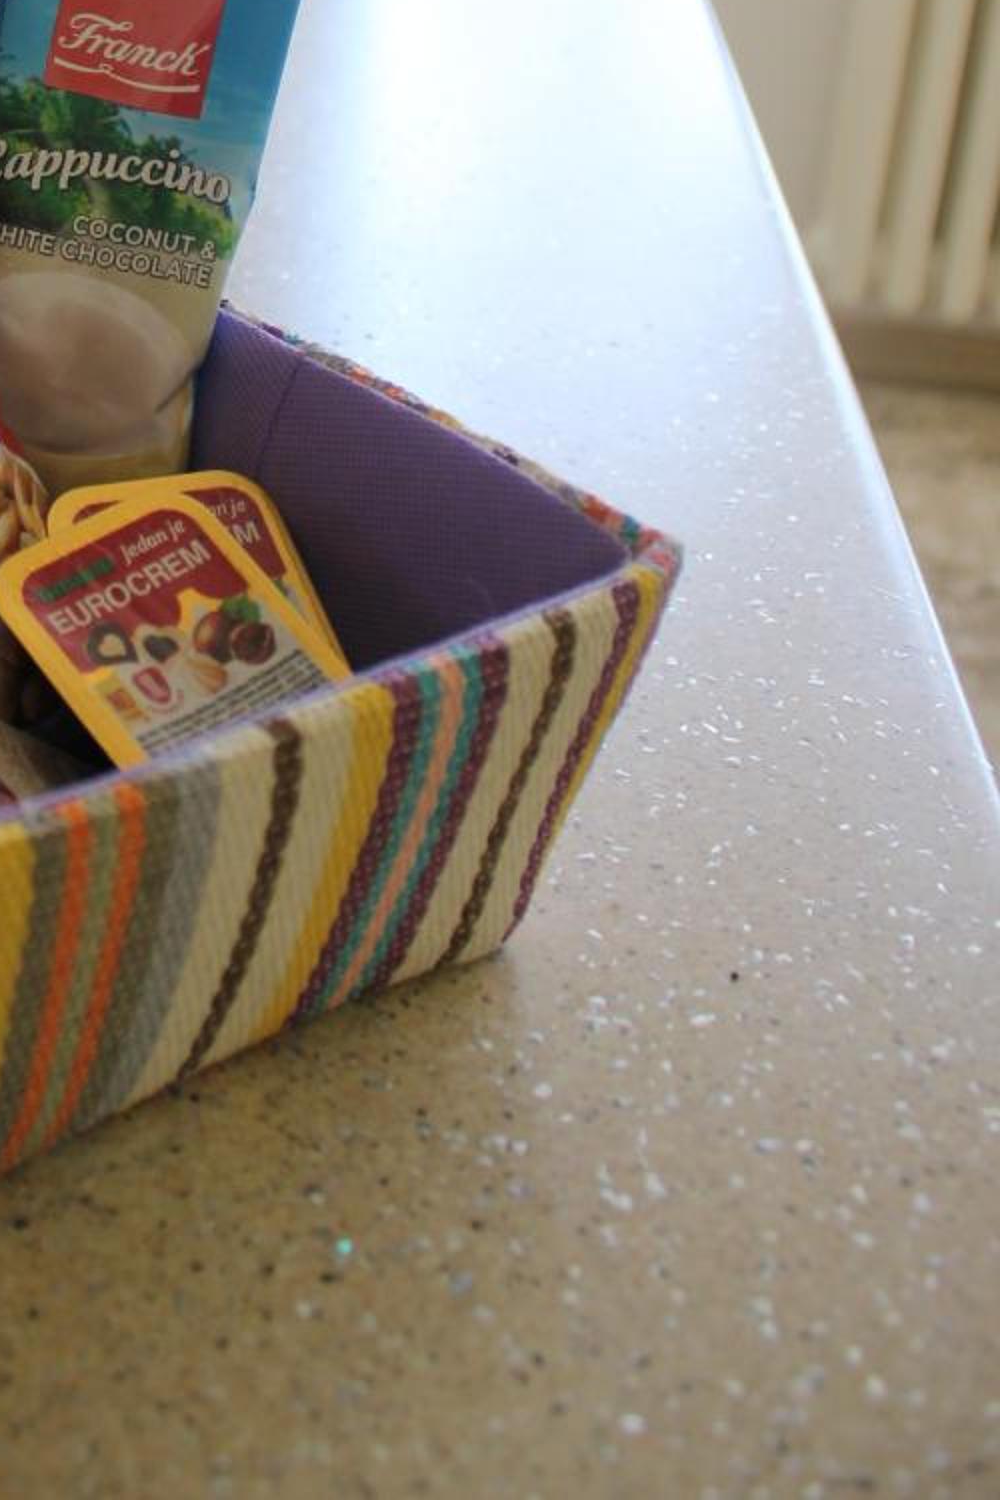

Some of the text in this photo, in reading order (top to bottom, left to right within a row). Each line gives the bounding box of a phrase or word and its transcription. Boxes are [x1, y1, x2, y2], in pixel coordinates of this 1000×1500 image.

[57, 12, 213, 76] Franck
[60, 238, 215, 289] CHOCOLATE
[72, 214, 218, 262] COCONUT &
[47, 537, 213, 636] EUROCREM
